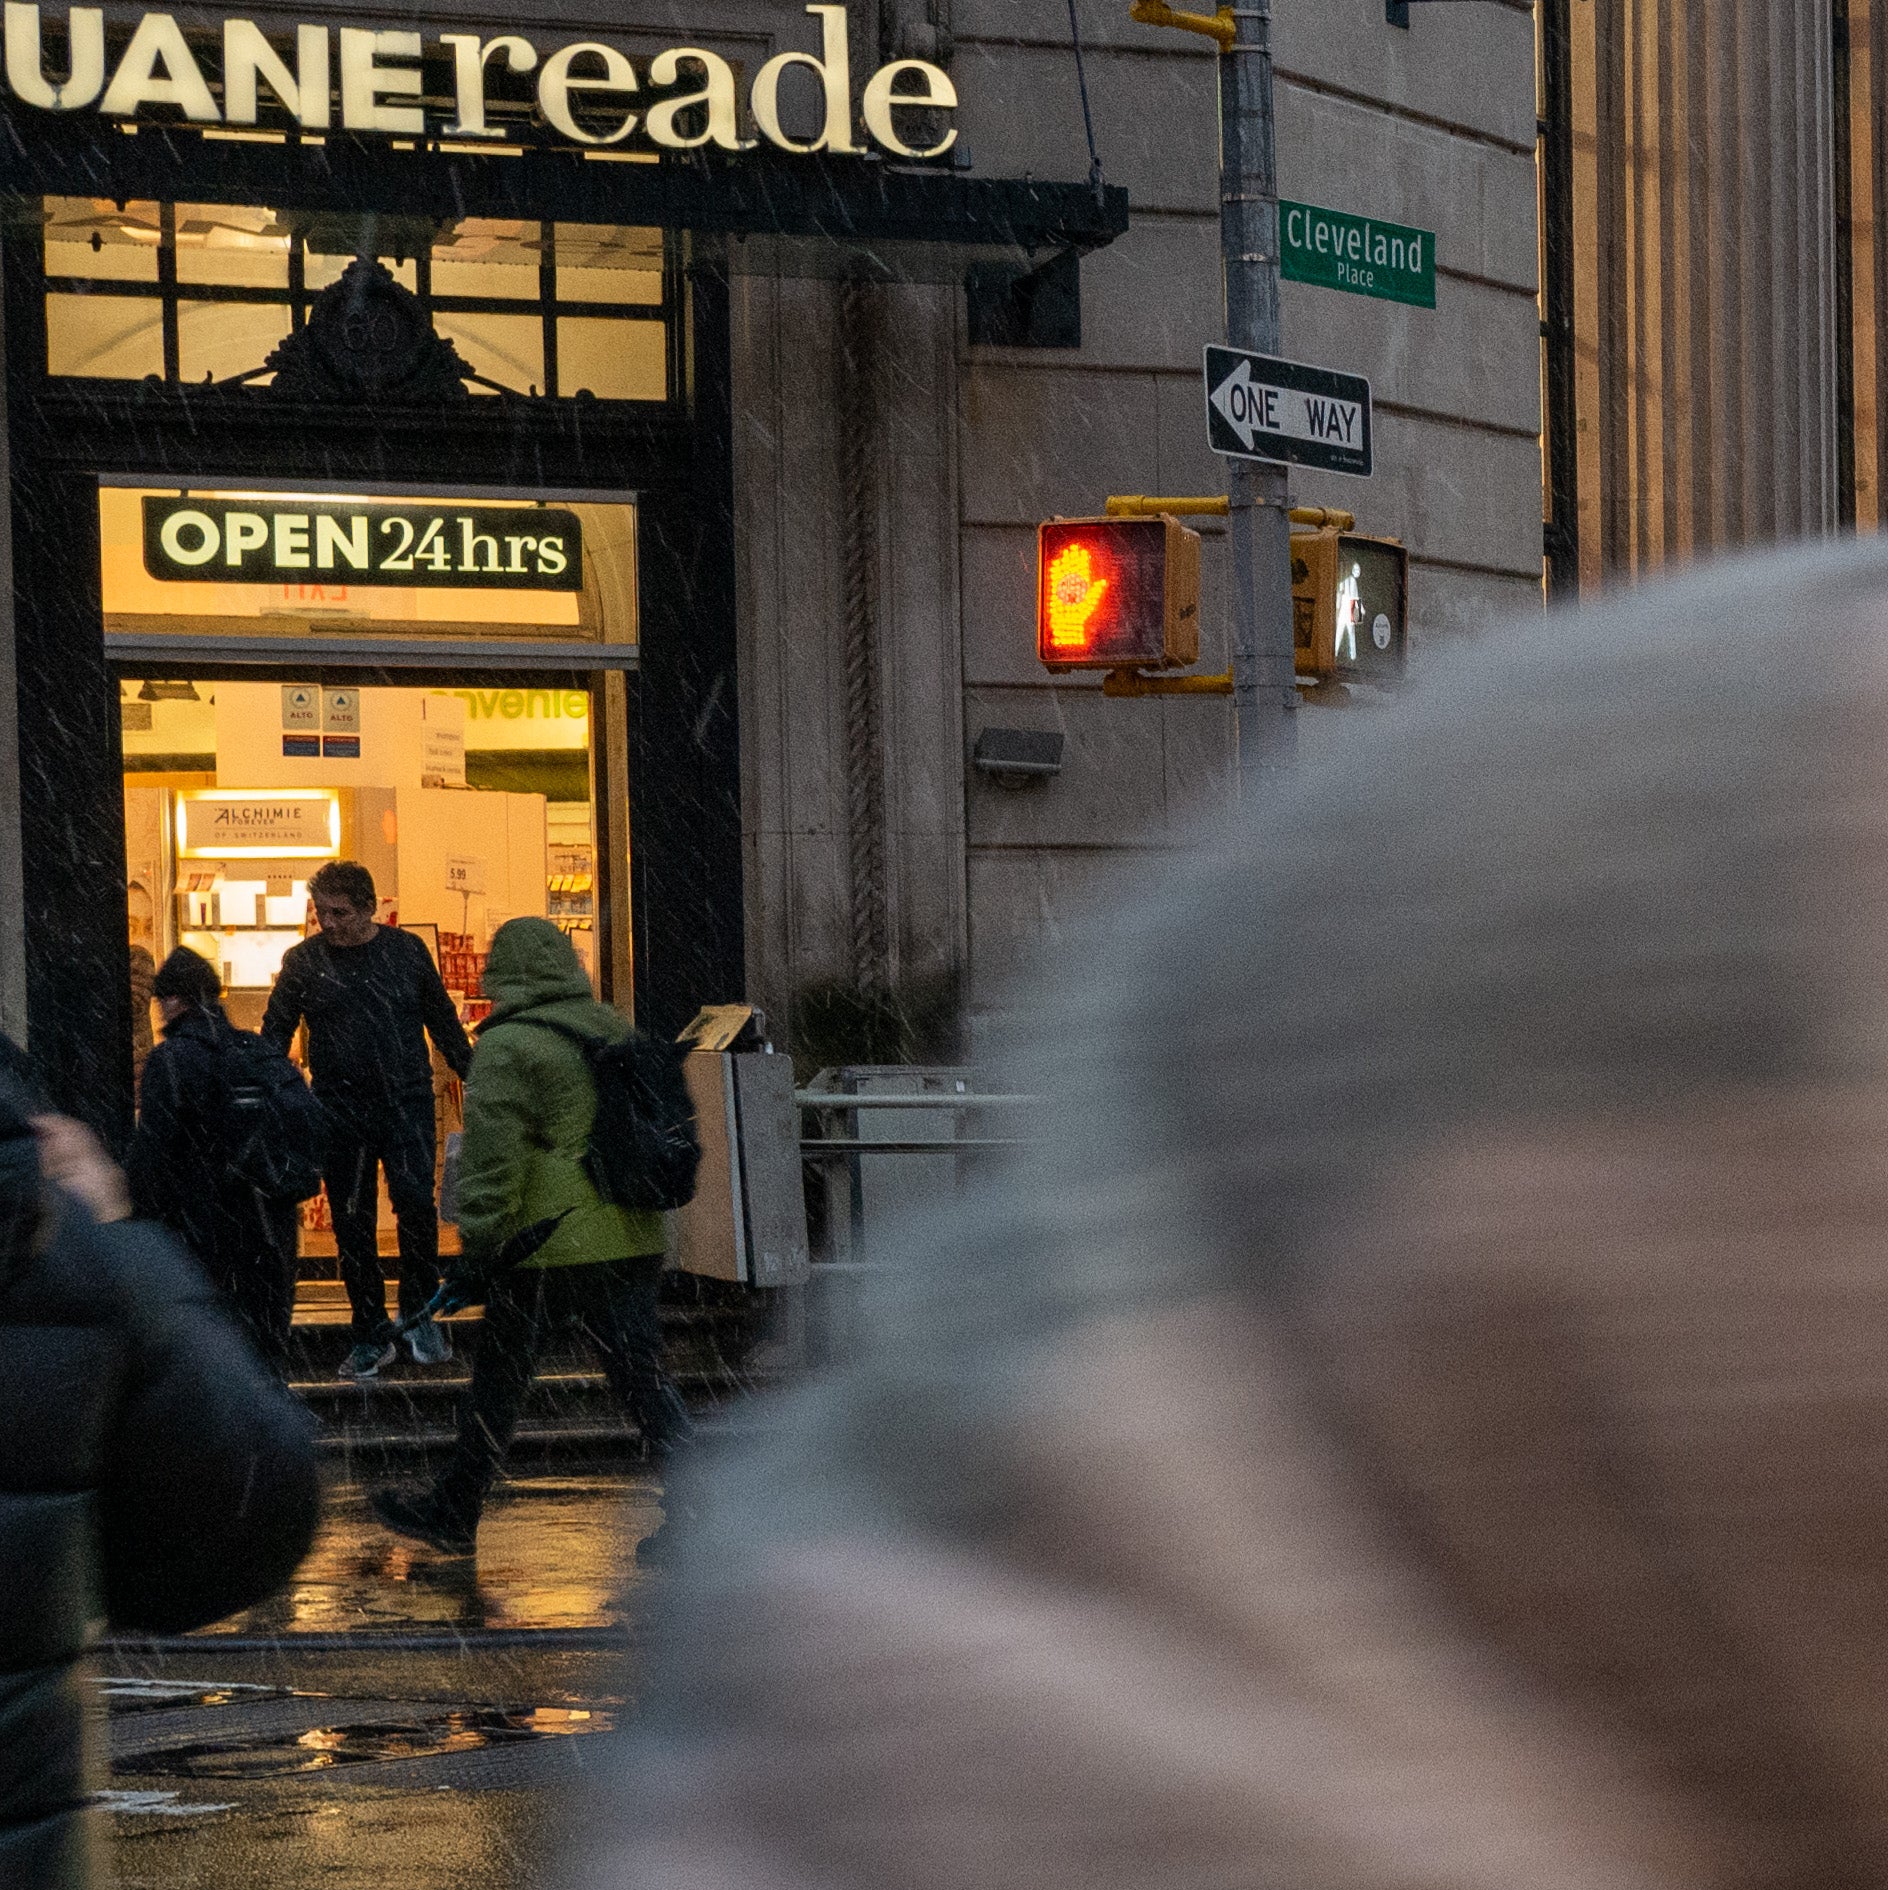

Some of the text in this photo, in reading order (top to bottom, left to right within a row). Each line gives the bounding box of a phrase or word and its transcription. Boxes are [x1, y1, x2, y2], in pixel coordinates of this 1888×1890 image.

[440, 3, 959, 158] reade
[1287, 208, 1423, 275] Cleveland
[1337, 261, 1375, 288] Place
[1229, 381, 1357, 445] ONE WAY
[160, 510, 567, 574] OPEN 24hrs
[290, 711, 313, 719] ALTO
[330, 714, 353, 722] ALTO
[430, 689, 588, 720] nvenie
[214, 807, 302, 825] ALCHIMIE
